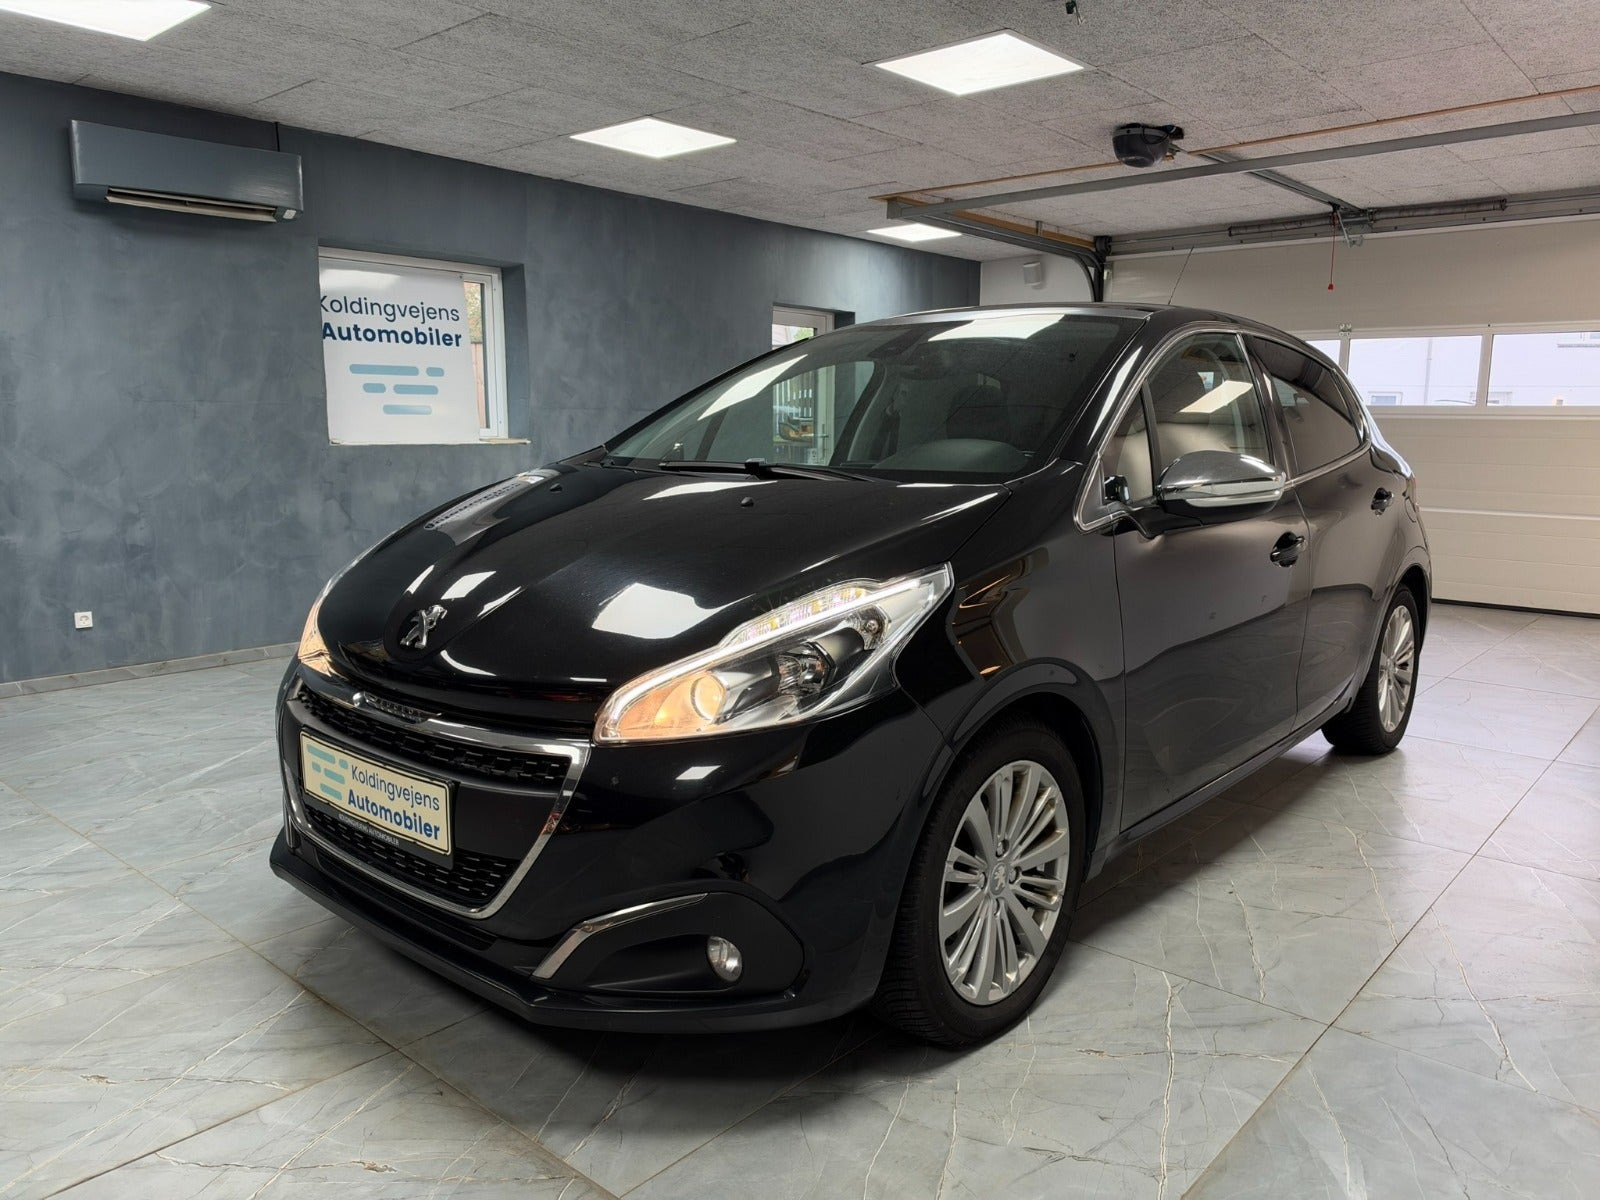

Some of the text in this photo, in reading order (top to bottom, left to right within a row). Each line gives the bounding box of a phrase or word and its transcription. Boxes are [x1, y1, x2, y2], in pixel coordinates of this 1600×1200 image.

[322, 322, 462, 347] Automobiler
[351, 765, 440, 811] Koldingvejens
[348, 789, 440, 840] Automobiler
